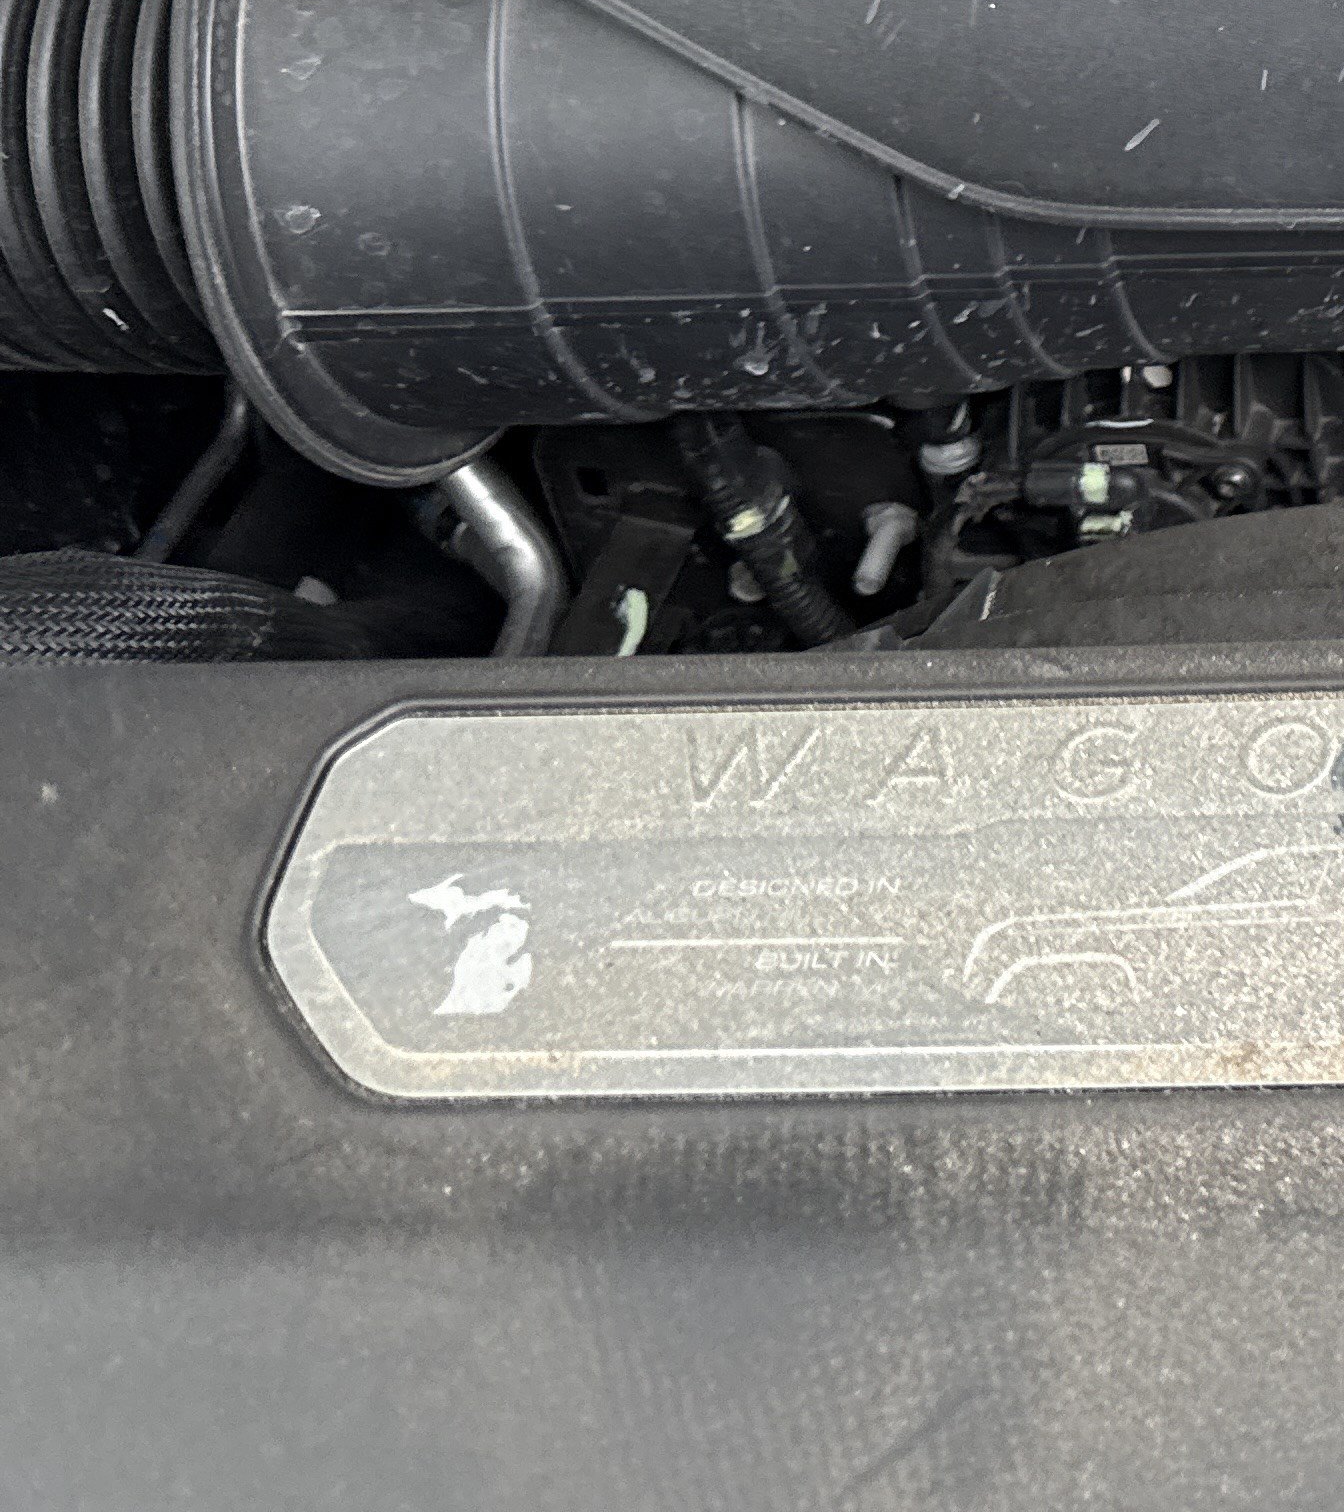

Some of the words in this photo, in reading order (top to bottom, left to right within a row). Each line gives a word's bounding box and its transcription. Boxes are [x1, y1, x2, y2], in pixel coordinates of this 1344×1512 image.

[691, 877, 860, 898] DESIGNED
[867, 877, 902, 895] IN
[754, 950, 851, 971] BUILT
[854, 950, 891, 969] IN
